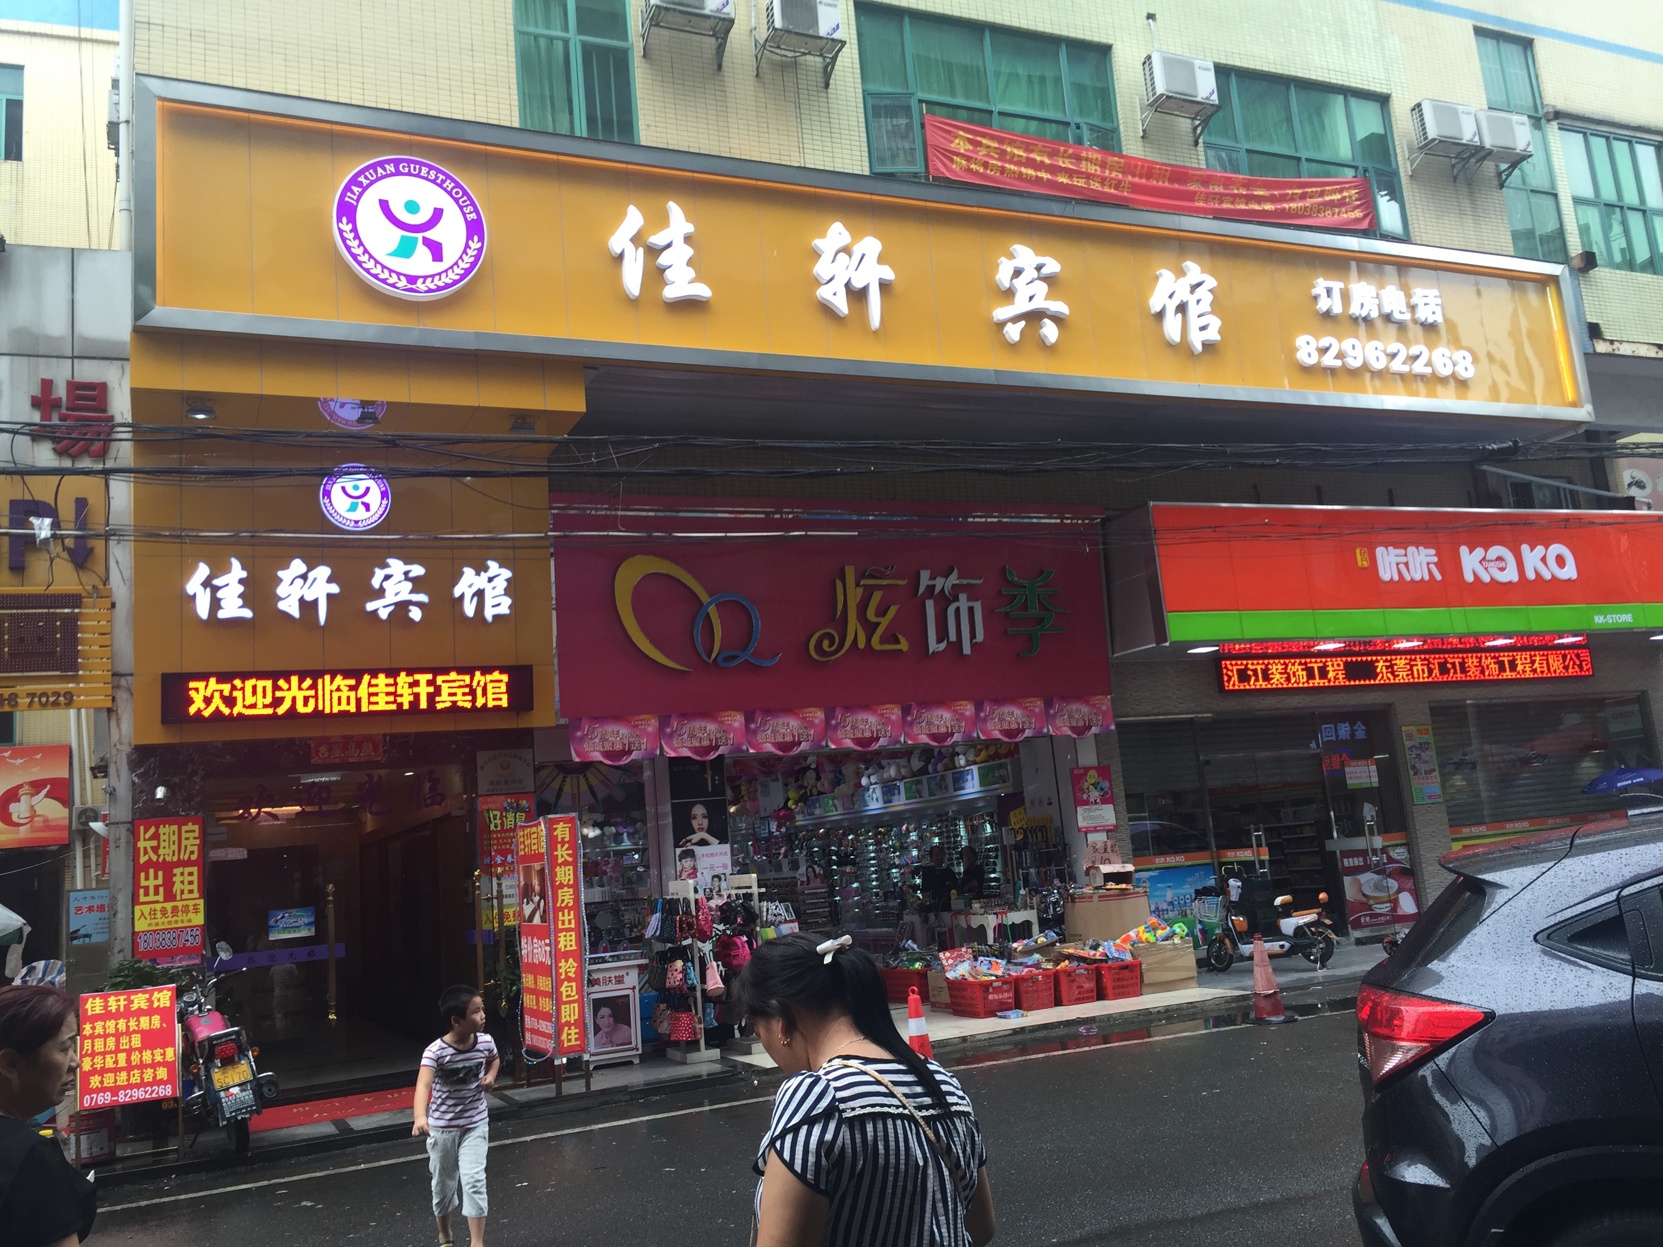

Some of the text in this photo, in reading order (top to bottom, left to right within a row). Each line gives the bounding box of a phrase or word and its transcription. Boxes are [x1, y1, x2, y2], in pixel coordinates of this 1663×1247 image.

[344, 162, 478, 222] JIA XUAN GUESTHOUSE
[607, 200, 1222, 356] 佳轩宾馆
[1310, 277, 1443, 325] 订房电话
[1295, 334, 1475, 380] 82962268
[1375, 545, 1442, 582] 咔咔
[186, 556, 513, 627] 佳轩宾馆
[808, 563, 1071, 662] 炫饰季
[1594, 613, 1634, 624] KK-STORE
[1226, 660, 1346, 687] 汇江装饰工程
[26, 690, 75, 709] 7029
[187, 671, 510, 718] 欢迎光临佳轩宾馆
[137, 822, 200, 865] 长期房
[139, 866, 200, 903] 出租
[137, 903, 202, 922] 入住免费停车
[552, 821, 581, 1048] 有长期房出租 拎包即住
[85, 990, 172, 1016] 佳轩宾馆
[82, 1034, 142, 1055] 月租房 出租
[82, 1047, 176, 1072] 豪华配置 价格实惠
[83, 1084, 172, 1107] 0769-82962268
[89, 1066, 168, 1089] 欢迎进店咨询
